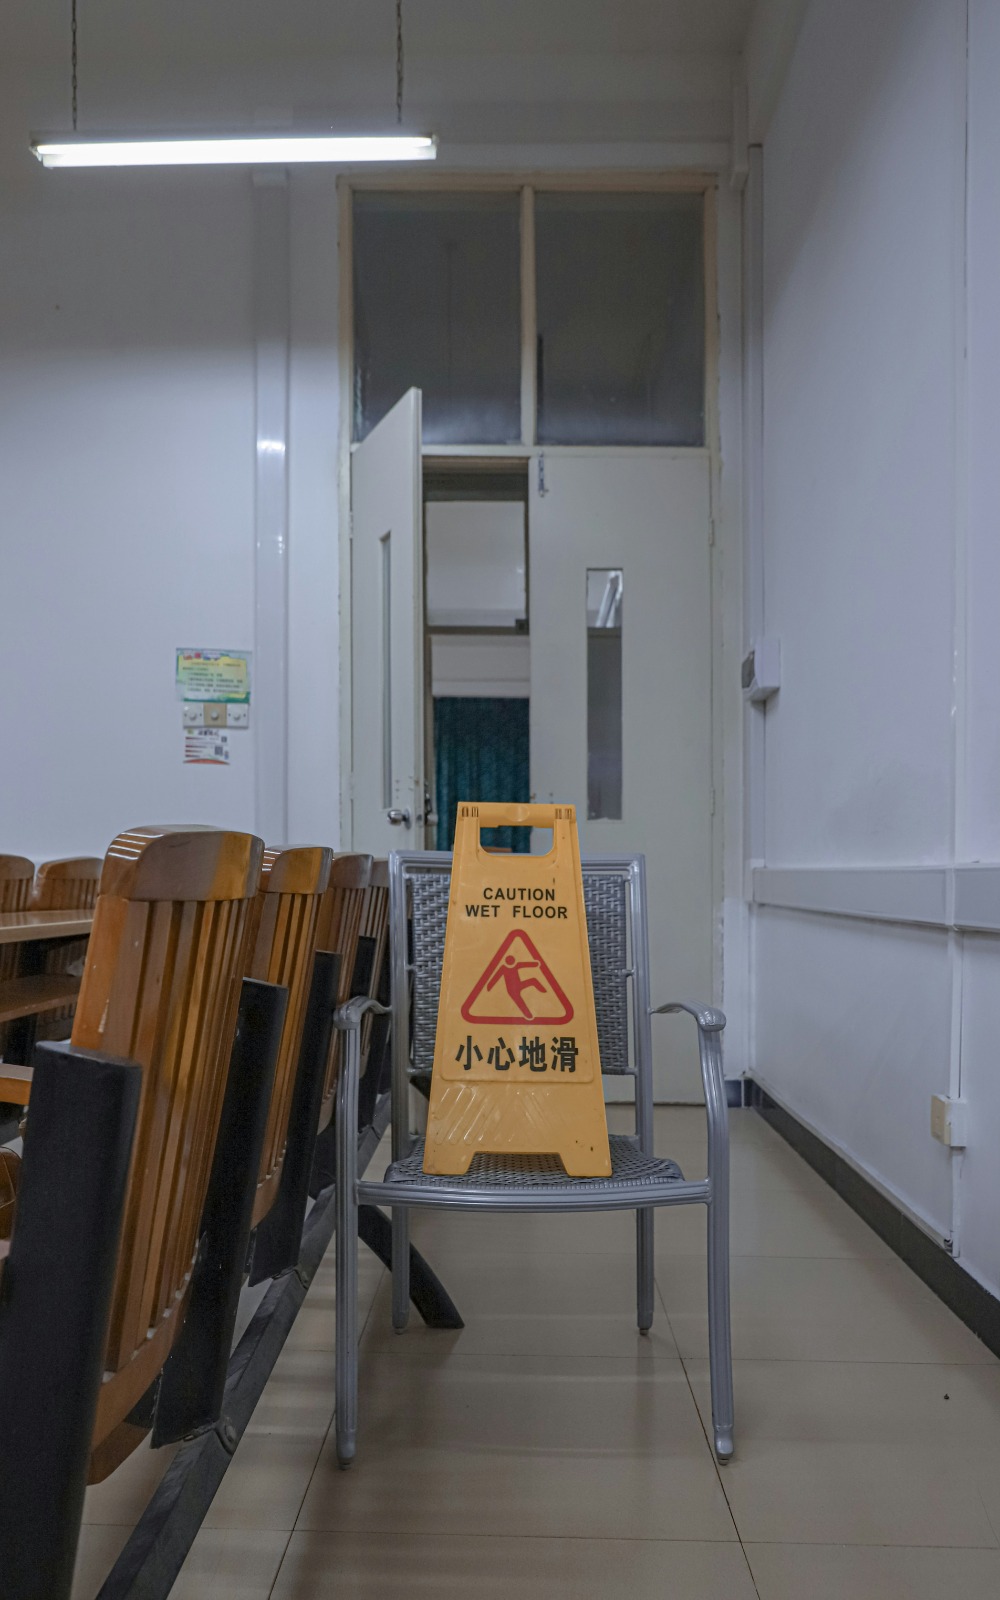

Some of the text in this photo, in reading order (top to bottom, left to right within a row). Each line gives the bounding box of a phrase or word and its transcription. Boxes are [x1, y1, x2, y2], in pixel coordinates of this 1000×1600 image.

[483, 887, 555, 901] CAUTION
[465, 905, 568, 919] WET FLOOR
[455, 1035, 579, 1073] 小心地滑
